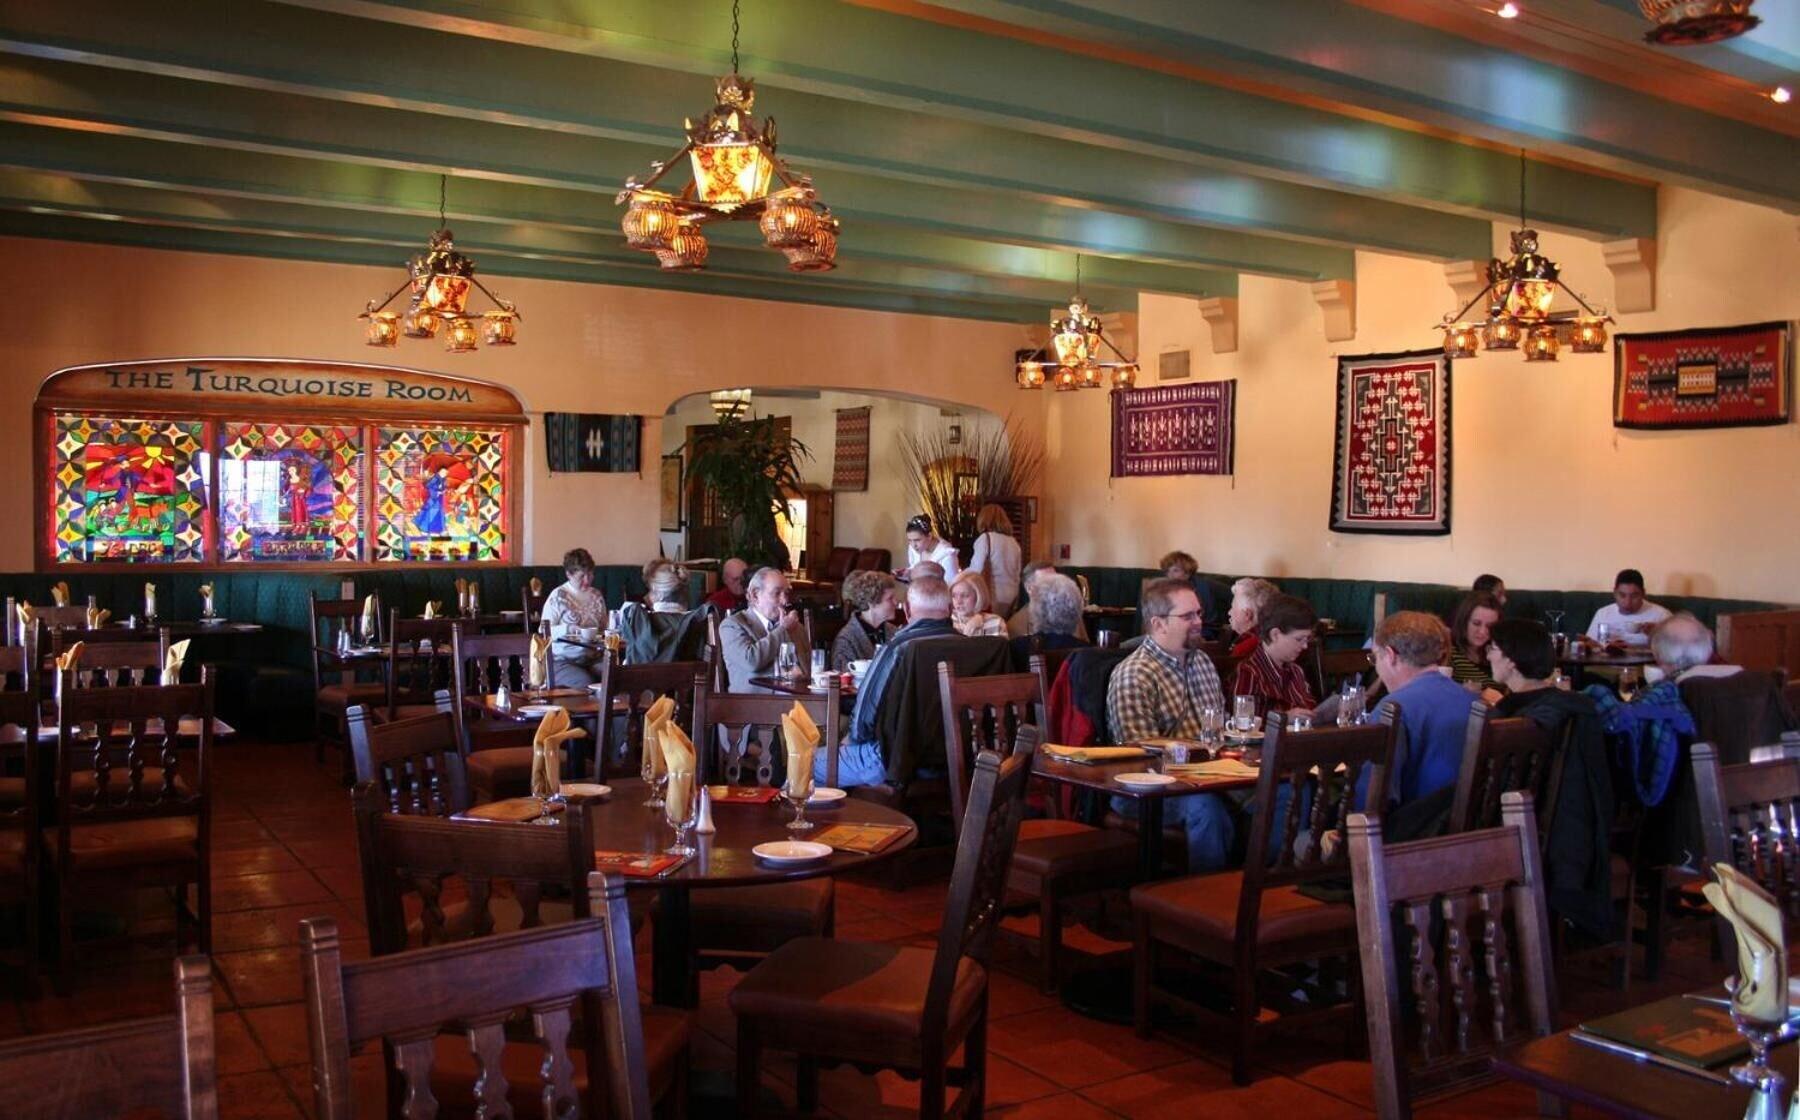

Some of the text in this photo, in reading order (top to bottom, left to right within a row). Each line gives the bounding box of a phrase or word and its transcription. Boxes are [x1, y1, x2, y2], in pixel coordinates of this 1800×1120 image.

[105, 367, 473, 403] THE TURQUOISE ROOM
